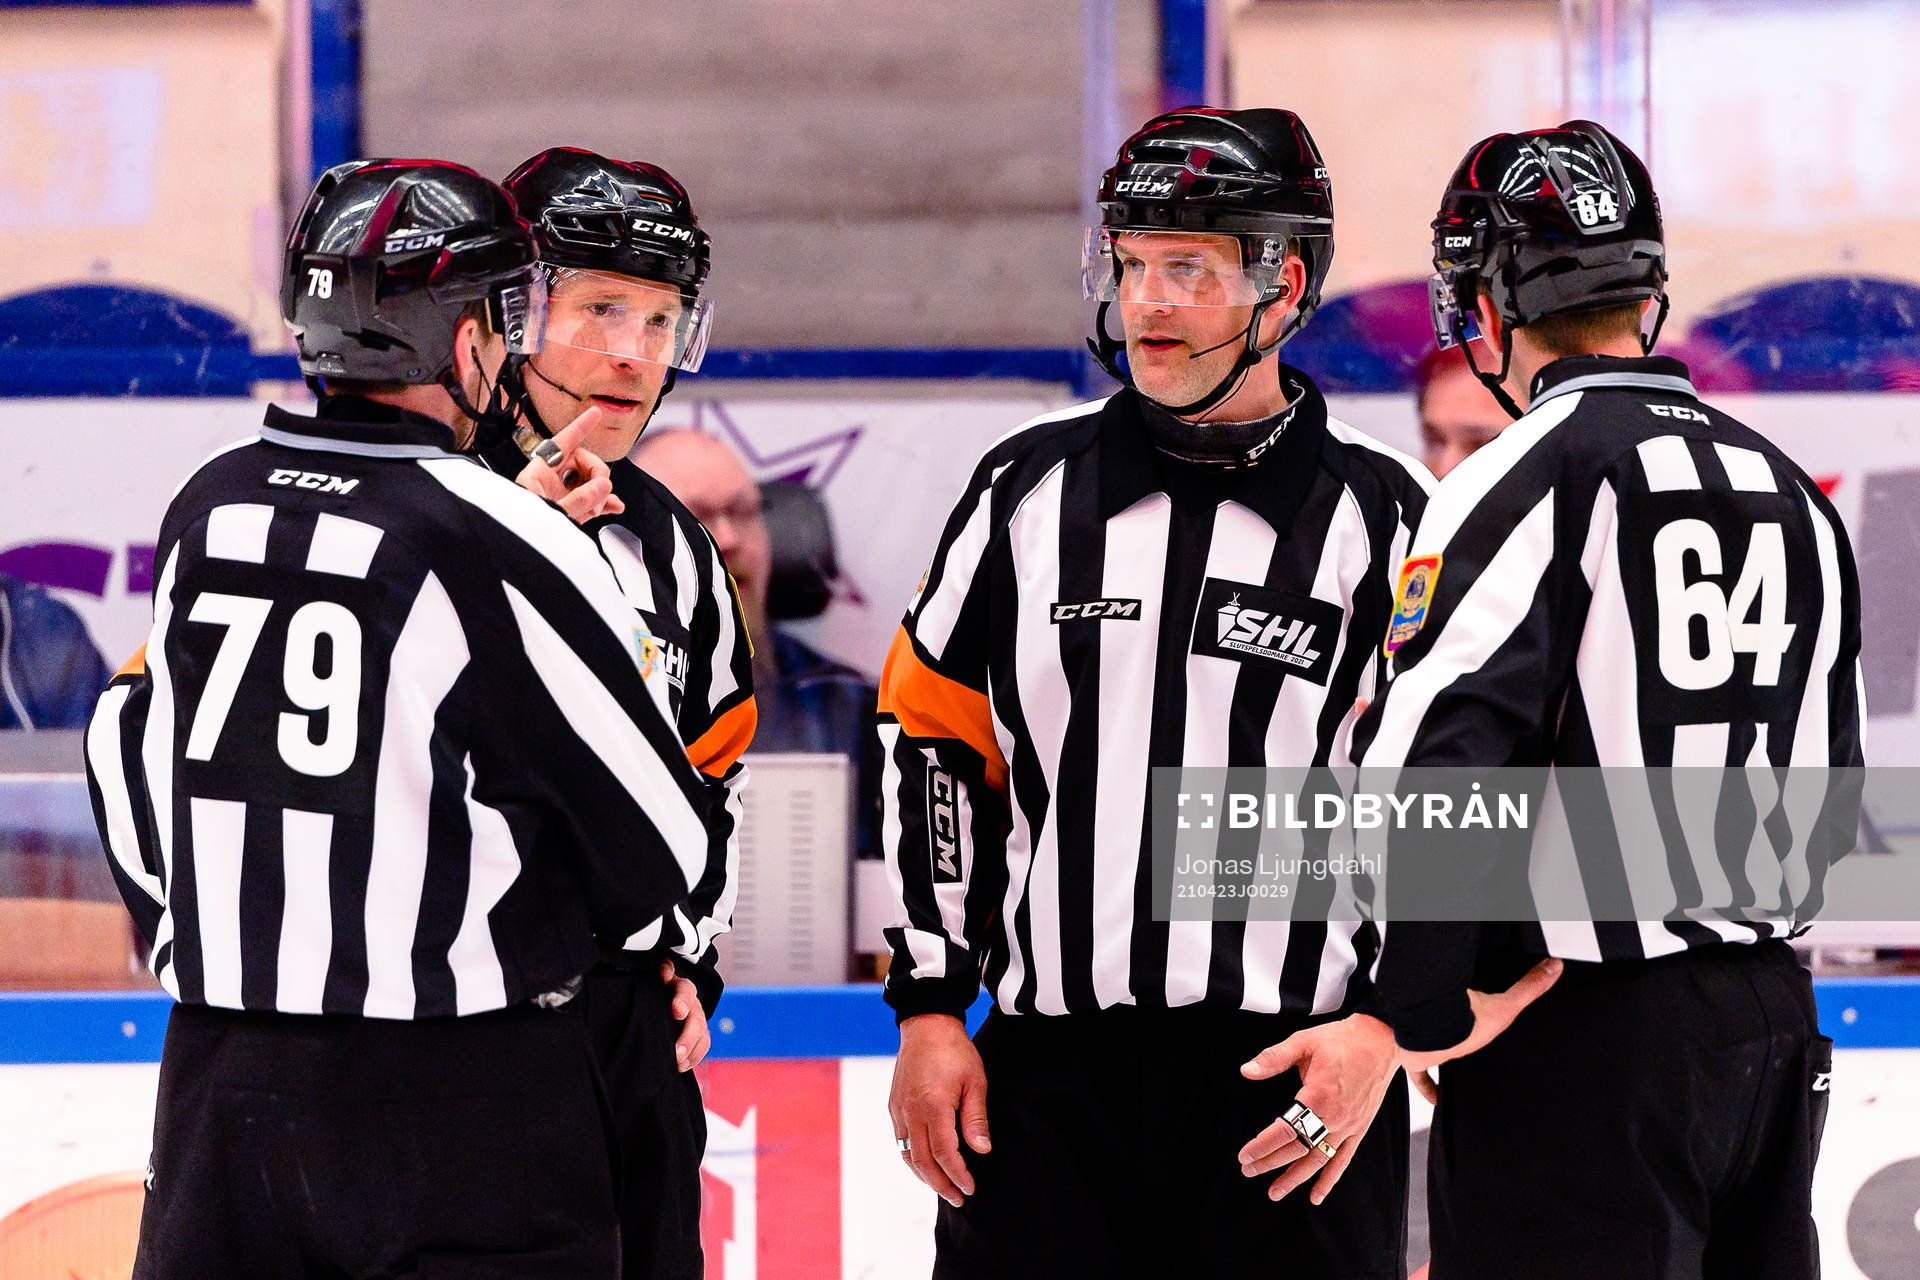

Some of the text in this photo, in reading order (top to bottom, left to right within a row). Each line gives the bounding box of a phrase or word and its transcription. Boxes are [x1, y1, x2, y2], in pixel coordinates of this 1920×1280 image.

[1116, 181, 1174, 193] CCM
[1576, 191, 1619, 226] 64
[385, 232, 445, 253] CCM
[631, 218, 691, 242] CCM
[1444, 236, 1472, 248] CCM
[307, 267, 333, 299] 79
[1645, 404, 1710, 426] CCM
[1246, 406, 1296, 460] CCM
[267, 468, 360, 495] CCM
[1053, 601, 1138, 620] CCM
[1653, 518, 1797, 691] 64
[1226, 608, 1321, 661] SHL
[1290, 656, 1305, 665] 2021
[185, 591, 362, 777] 79
[933, 770, 957, 877] CCM
